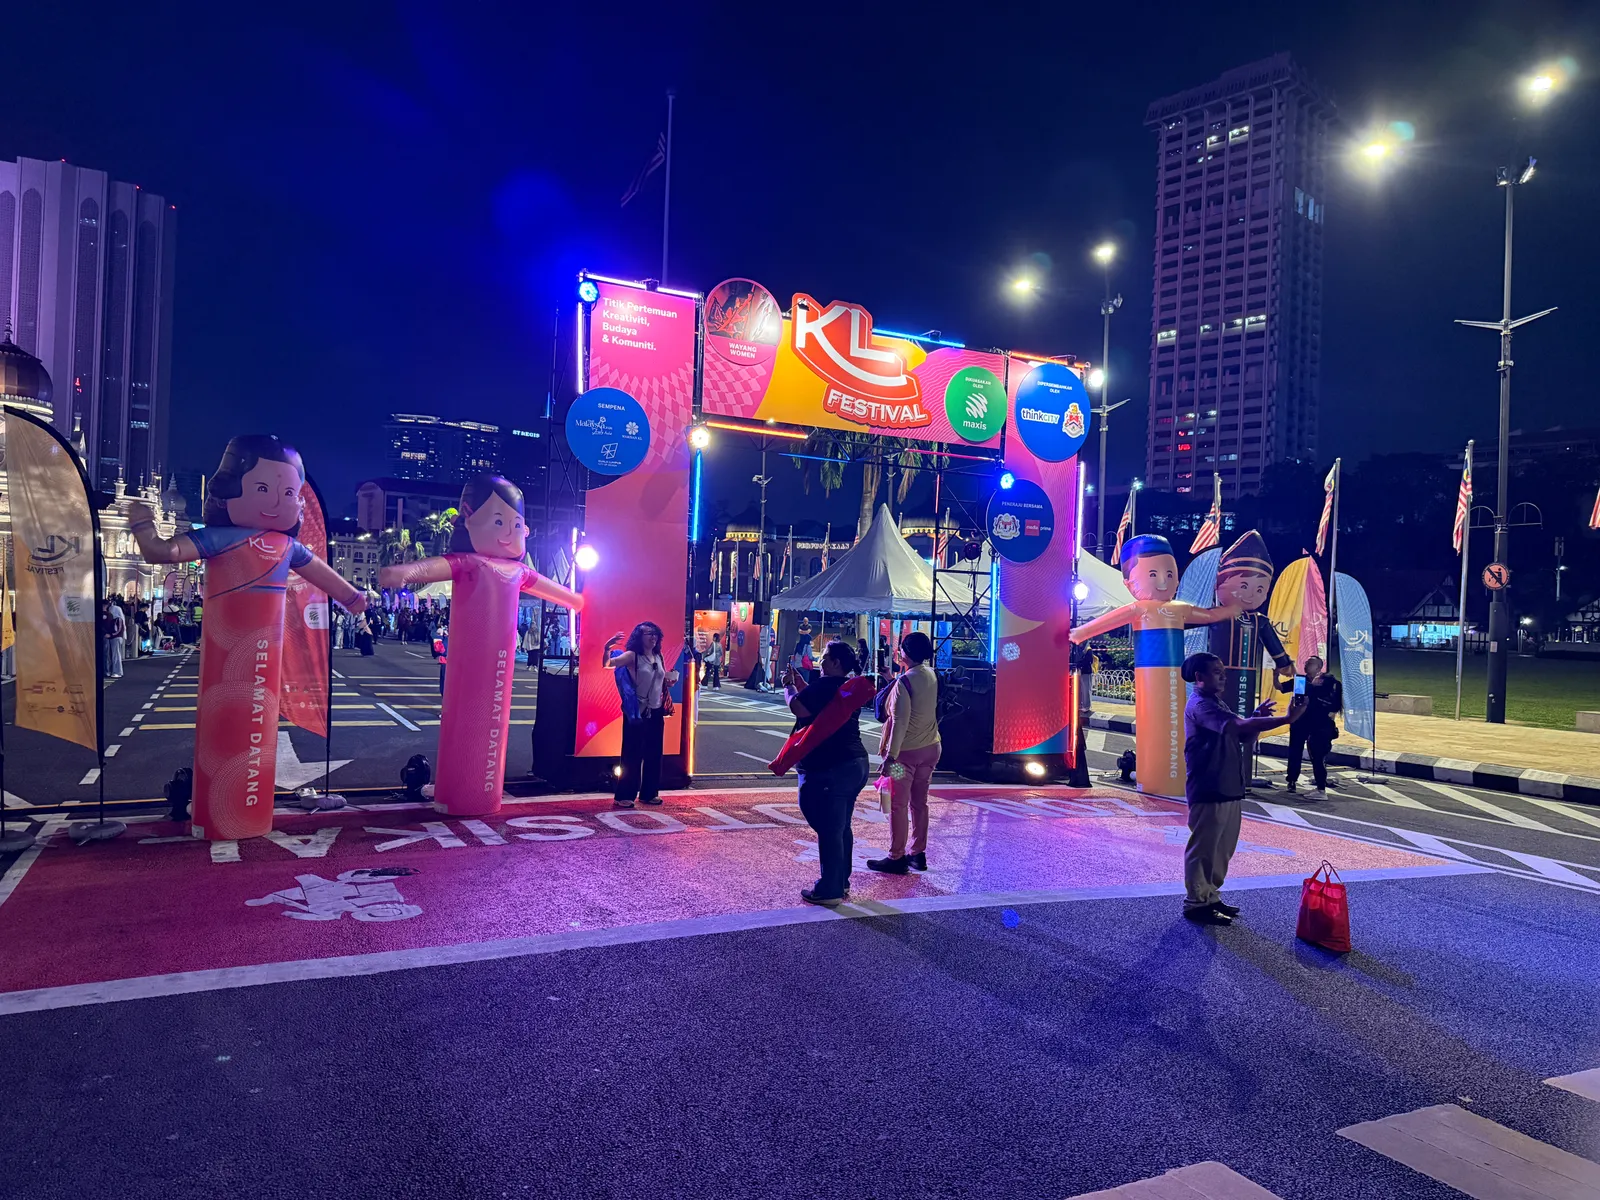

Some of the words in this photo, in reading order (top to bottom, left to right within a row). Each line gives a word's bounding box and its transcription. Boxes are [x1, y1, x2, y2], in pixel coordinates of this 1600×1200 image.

[603, 297, 625, 309] Titik
[627, 302, 678, 318] Pertemuan
[602, 310, 651, 327] Kreativiti,
[602, 322, 638, 336] Budaya
[602, 334, 610, 343] &
[611, 336, 657, 351] Komuniti.
[729, 342, 757, 353] WAYANG
[795, 298, 908, 386] KL
[730, 349, 756, 359] WOMEN
[597, 402, 626, 411] SEMPENA
[827, 388, 928, 423] FESTIVAL
[963, 420, 987, 430] maxis
[248, 537, 277, 553] KL
[252, 639, 269, 725] SELAMAT
[492, 649, 507, 722] SELAMAT
[1169, 670, 1178, 725] SELAMAT
[484, 728, 500, 792] DATANG
[1169, 730, 1178, 778] DATANG
[246, 732, 263, 807] DATANG
